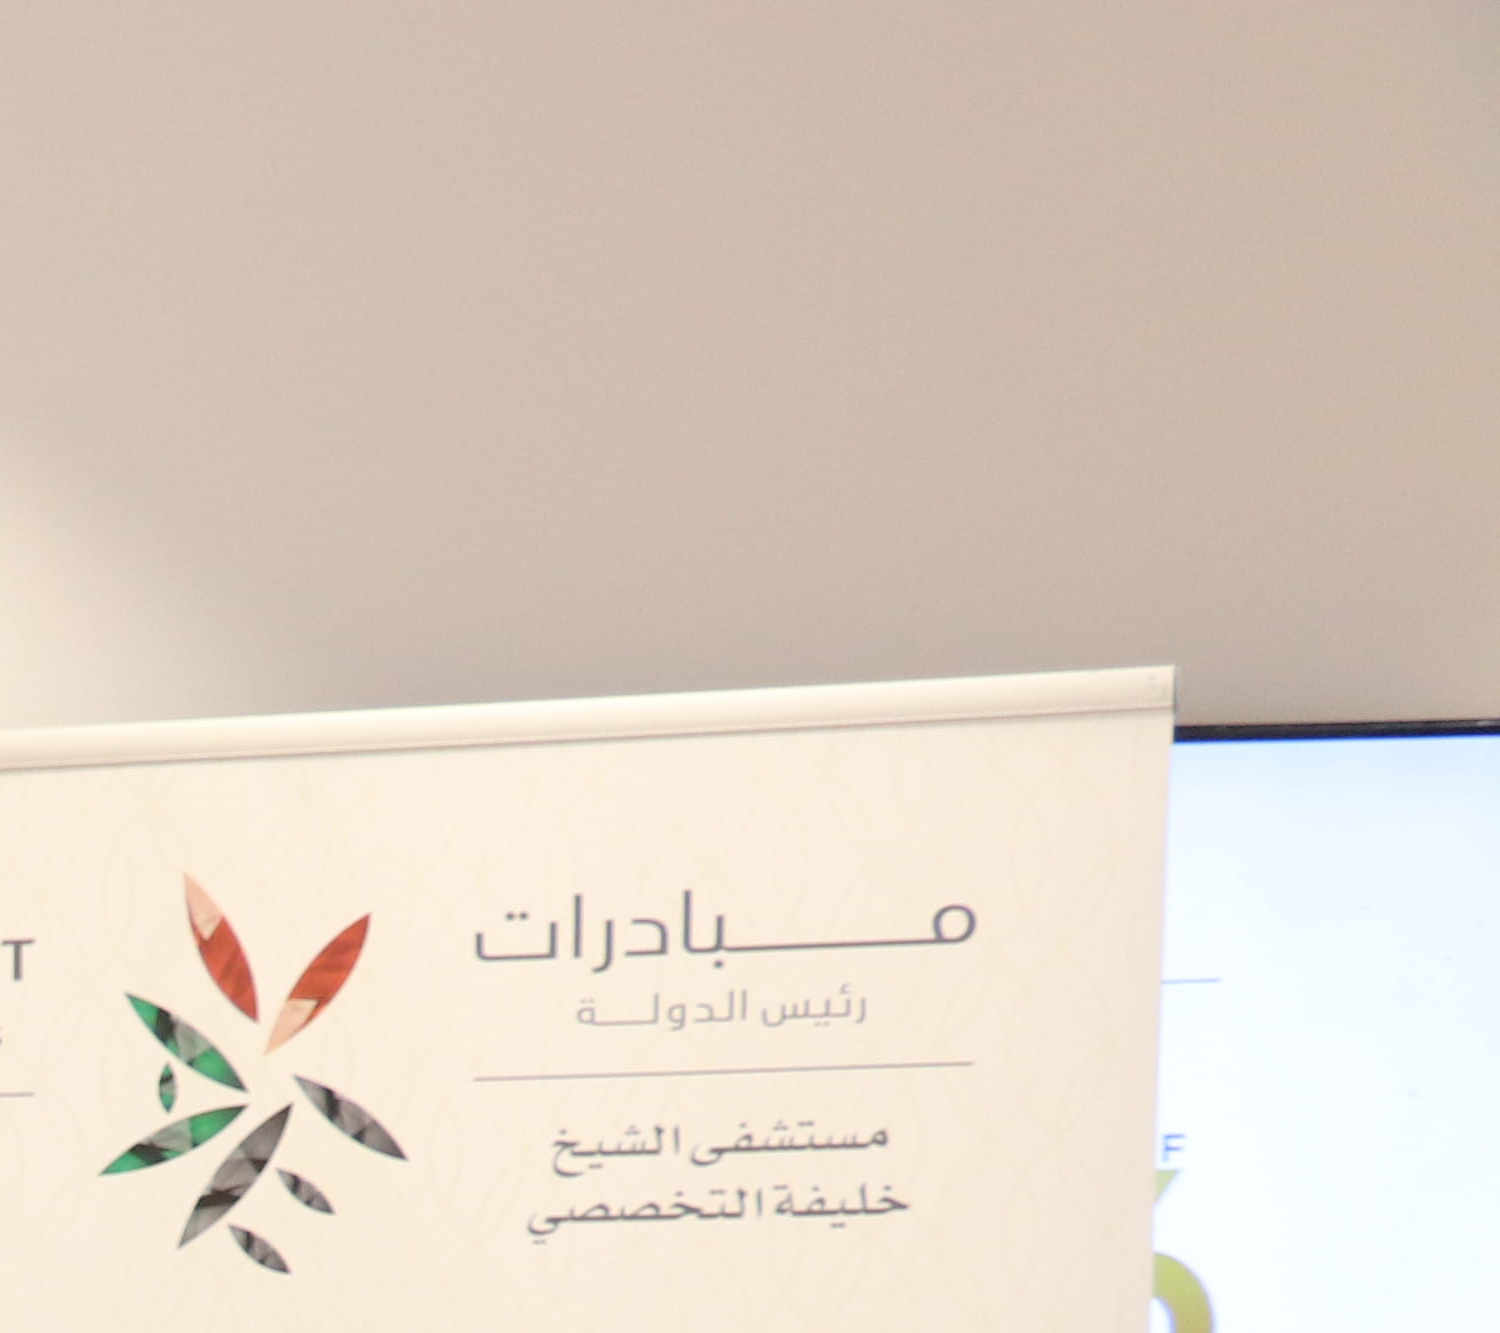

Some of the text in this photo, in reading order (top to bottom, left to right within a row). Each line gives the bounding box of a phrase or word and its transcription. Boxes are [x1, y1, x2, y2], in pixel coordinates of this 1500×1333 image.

[474, 889, 977, 974] مبادرات
[576, 982, 868, 1031] رئيس الدولة
[552, 1121, 889, 1178] مستشفى الشيخ
[527, 1182, 910, 1244] خليفة التخصصي
